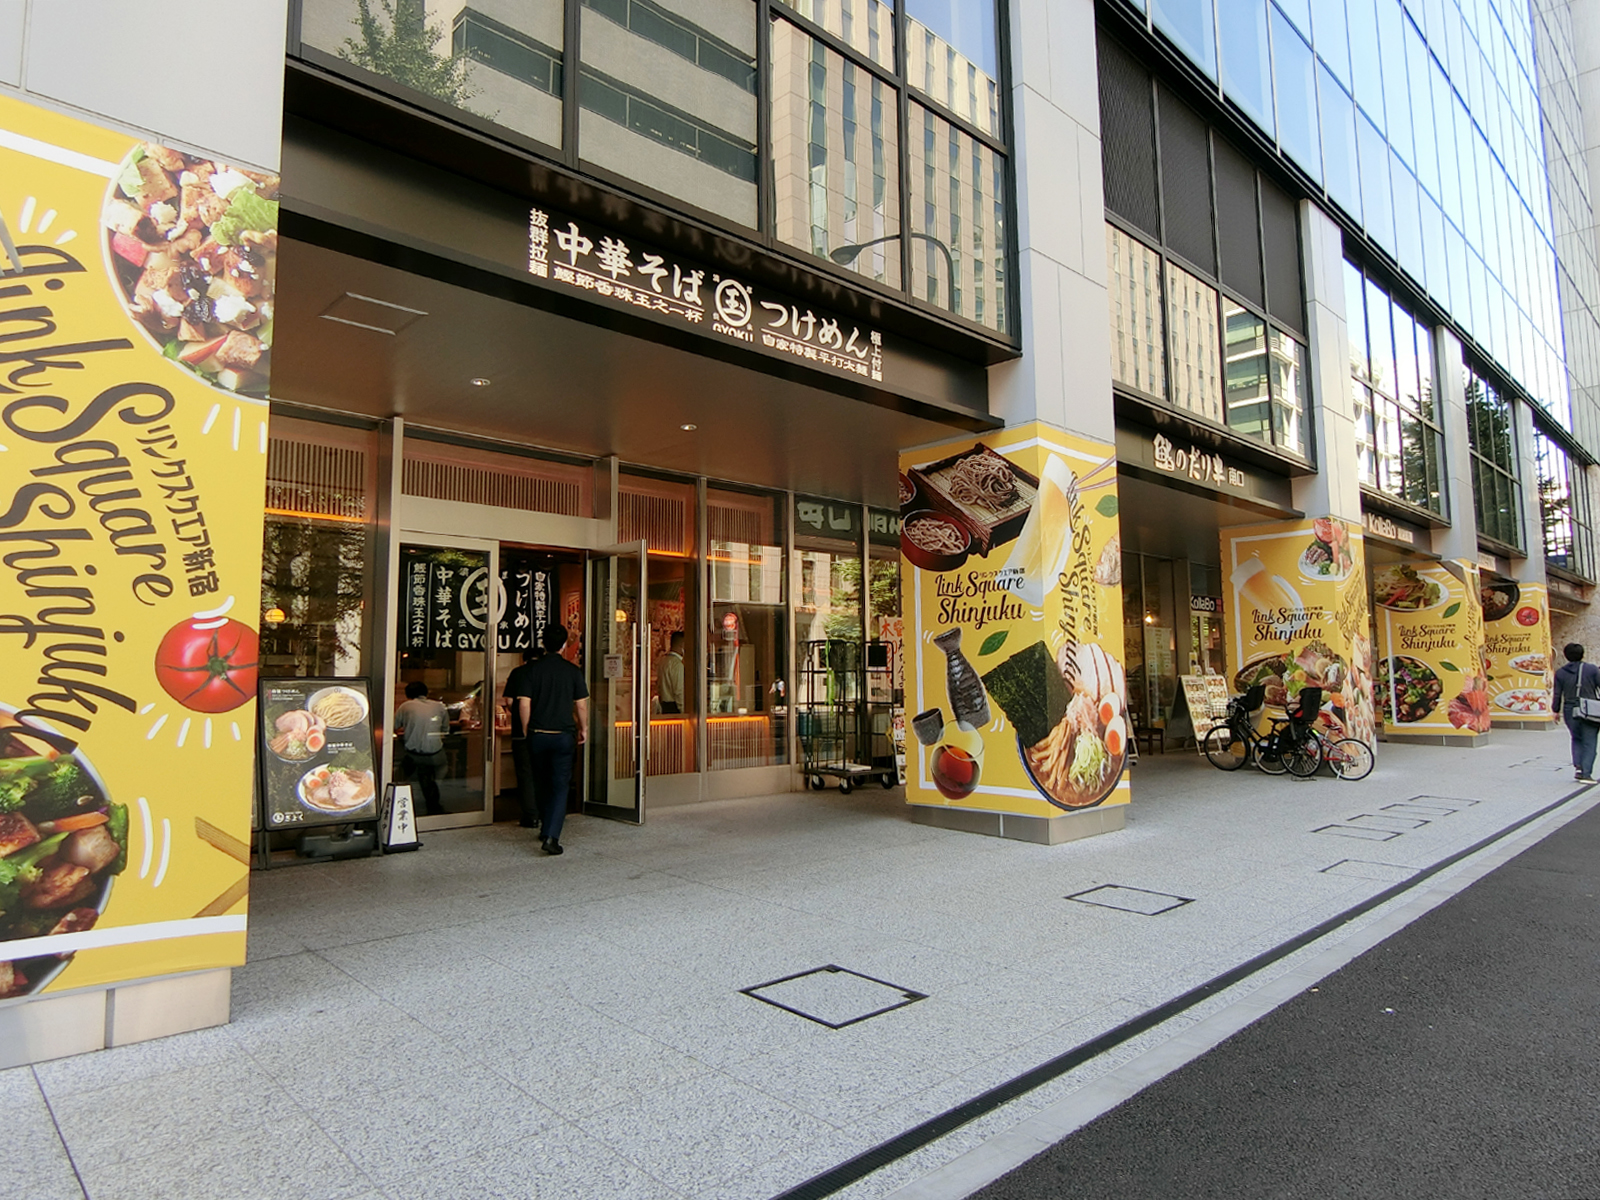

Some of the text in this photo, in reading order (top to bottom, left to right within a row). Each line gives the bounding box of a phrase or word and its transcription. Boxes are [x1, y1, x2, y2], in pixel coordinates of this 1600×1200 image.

[554, 222, 705, 307] 中華そば
[760, 300, 869, 359] つけめん
[2, 381, 176, 606] Square
[136, 422, 220, 598] リンクスクエア新宿
[434, 565, 454, 649] 中華そば
[935, 571, 1025, 599] Link Square
[1073, 525, 1093, 632] Square
[0, 482, 137, 753] Shinjuku
[514, 573, 531, 649] つけめん
[938, 594, 1026, 630] Shinjuku
[1059, 571, 1082, 692] Shinjuku
[1251, 606, 1324, 626] Link Square
[1254, 622, 1324, 645] Shinjuku
[1398, 625, 1418, 638] Link
[1418, 624, 1456, 639] Square
[1500, 633, 1531, 646] Square
[1400, 635, 1456, 653] Shinjuku
[1485, 643, 1531, 656] Shinjuku
